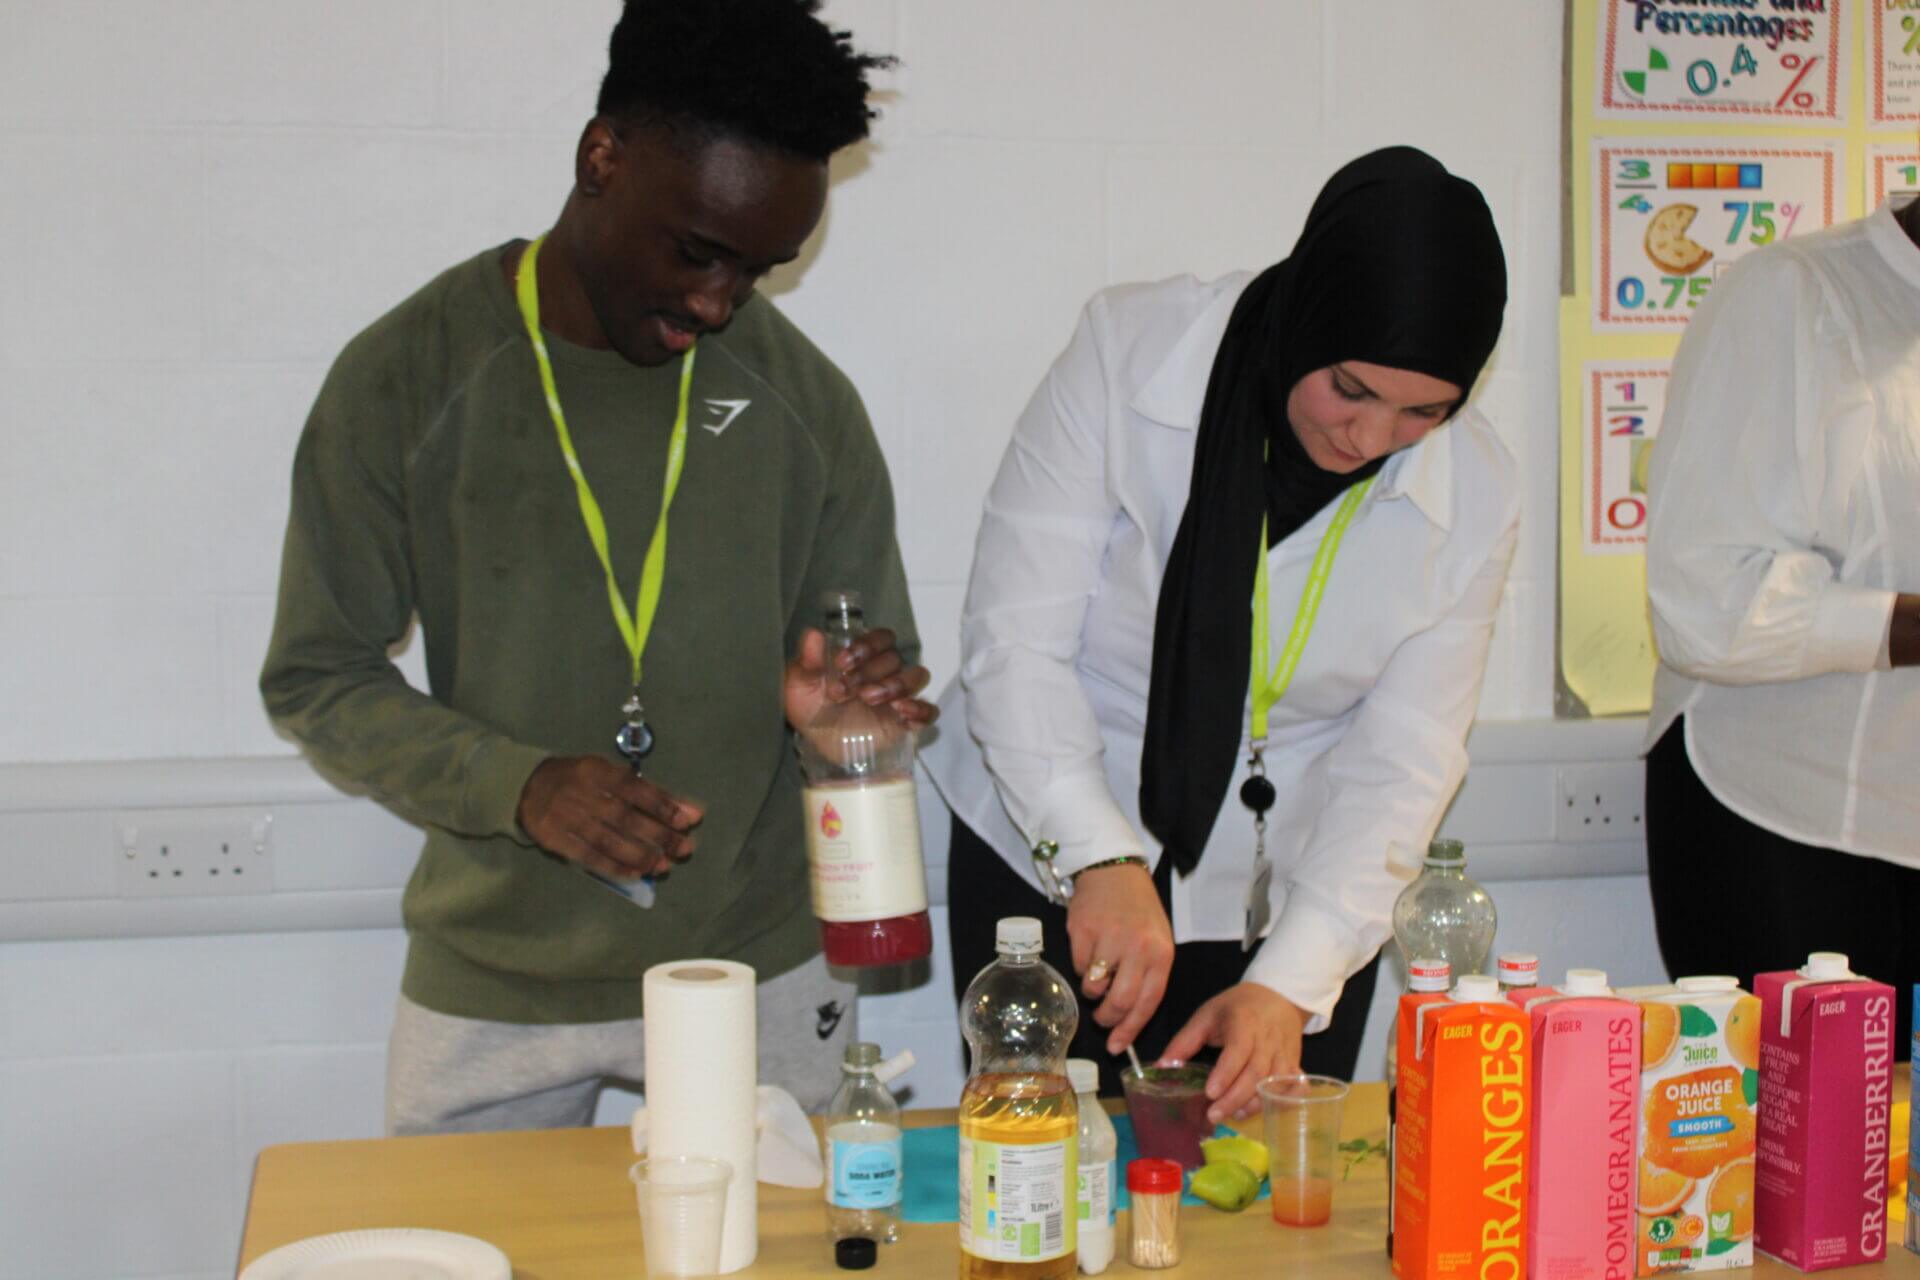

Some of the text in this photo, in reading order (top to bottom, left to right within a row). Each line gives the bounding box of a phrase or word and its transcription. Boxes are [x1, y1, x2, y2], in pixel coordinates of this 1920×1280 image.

[1634, 2, 1814, 49] Percentages
[1686, 43, 1758, 97] 0.4
[1617, 159, 1650, 180] 3
[1617, 194, 1653, 213] 4
[1614, 382, 1635, 402] 1
[1608, 416, 1645, 436] 2
[1820, 1001, 1846, 1016] EAGER
[1443, 1024, 1473, 1040] EAGER
[1552, 1020, 1582, 1034] EAGER
[1666, 1079, 1733, 1101] ORANGE
[1677, 1096, 1722, 1116] JUICE
[1678, 1120, 1722, 1133] SMOOTH
[1861, 996, 1890, 1257] CRANBERRIES
[1480, 1021, 1525, 1280] ORANGES
[1605, 1017, 1633, 1280] POMEGRANATES
